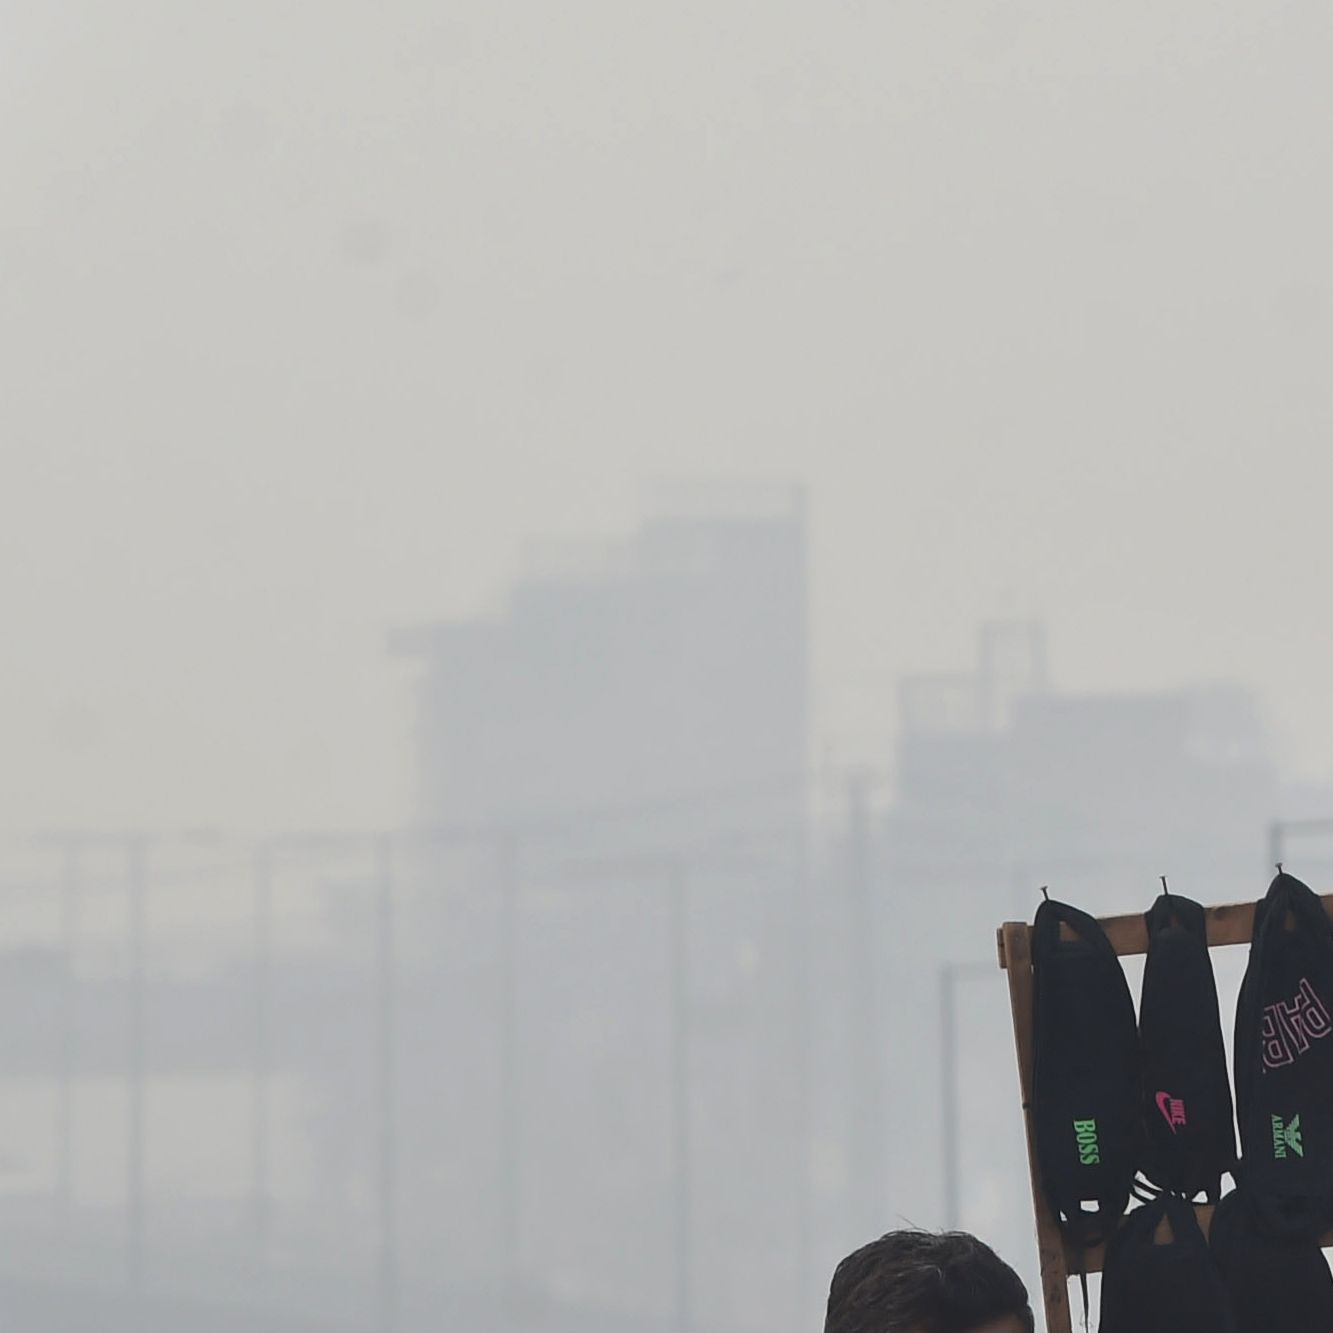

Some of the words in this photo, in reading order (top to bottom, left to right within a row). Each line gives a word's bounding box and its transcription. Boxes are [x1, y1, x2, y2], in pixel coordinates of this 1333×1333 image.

[1170, 1099, 1186, 1125] NIKE
[1073, 1118, 1100, 1165] BOSS
[1272, 1114, 1286, 1158] ARMANI
